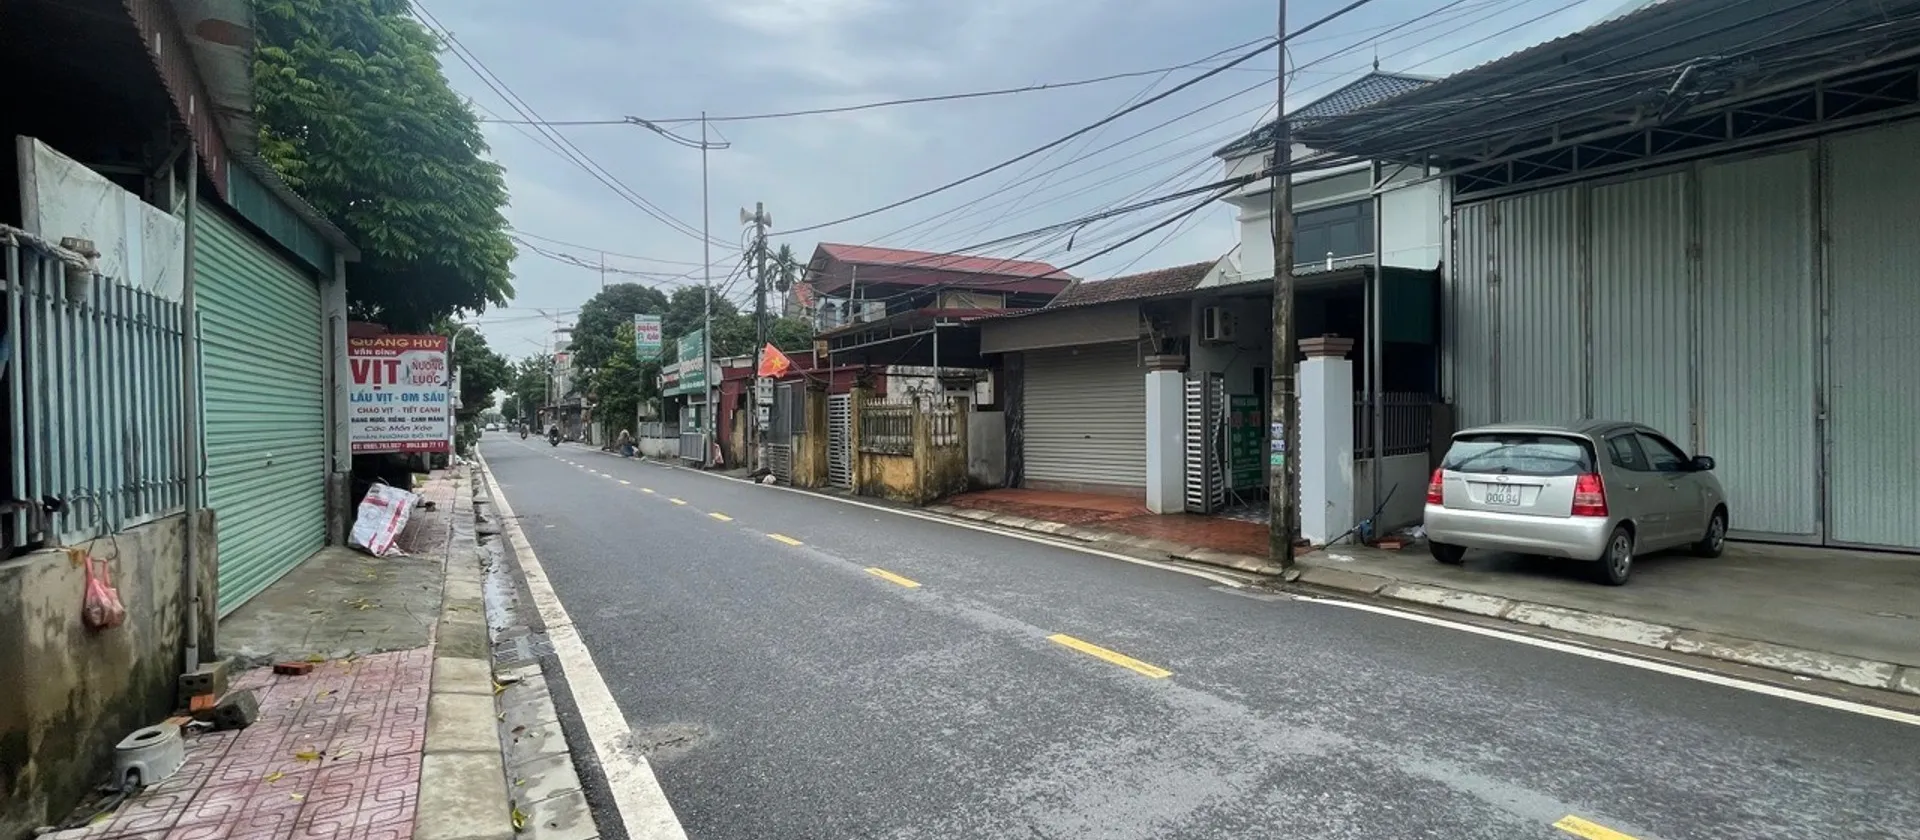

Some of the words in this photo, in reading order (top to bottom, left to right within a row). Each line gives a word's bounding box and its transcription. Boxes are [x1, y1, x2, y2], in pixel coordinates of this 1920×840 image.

[350, 338, 409, 347] QUANG
[413, 339, 441, 348] HUY
[350, 359, 401, 390] VỊT
[376, 393, 393, 404] VỊT
[401, 393, 419, 402] OM
[381, 406, 393, 414] VỊT
[402, 405, 417, 414] TIẾT
[420, 406, 441, 414] CANH
